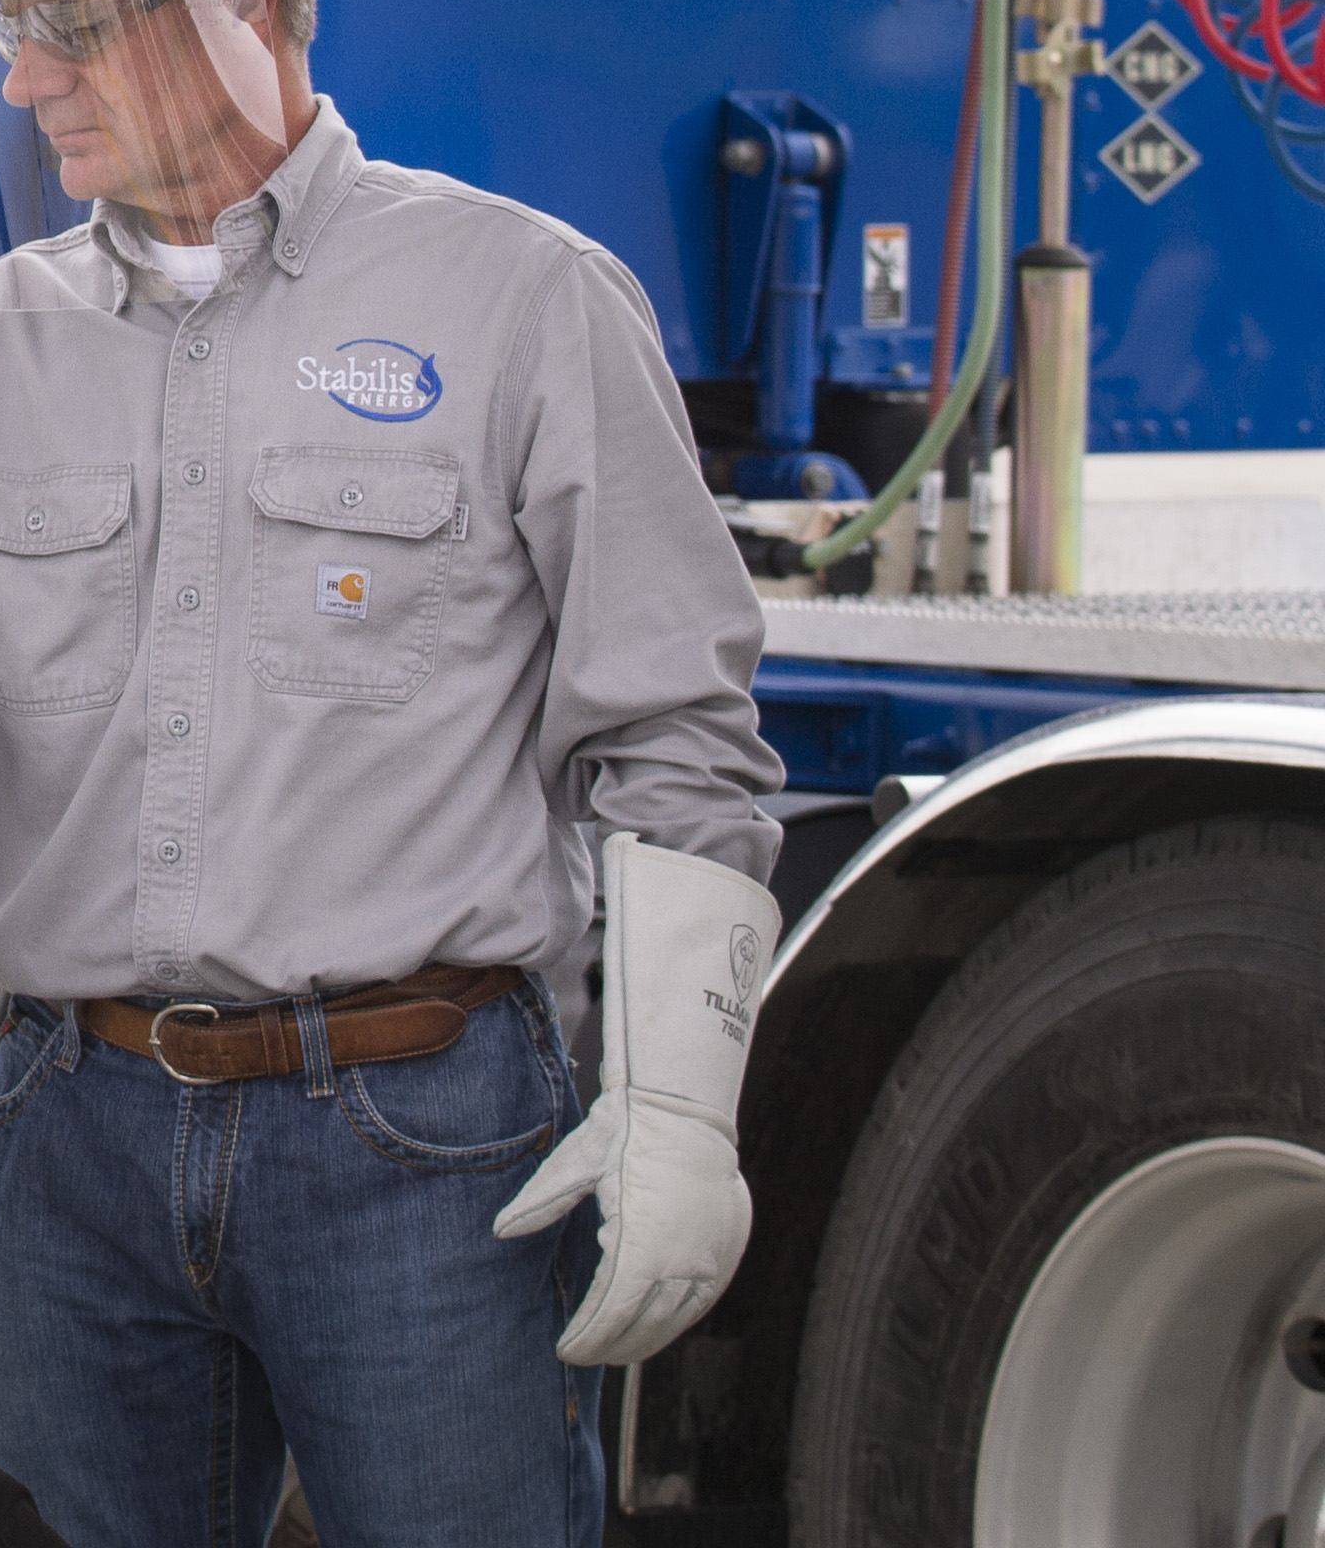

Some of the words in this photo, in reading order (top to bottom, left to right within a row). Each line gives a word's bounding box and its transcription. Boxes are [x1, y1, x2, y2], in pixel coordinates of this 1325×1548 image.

[296, 355, 415, 395] Stabilis
[345, 391, 430, 409] ENERGY
[327, 580, 339, 592] FR
